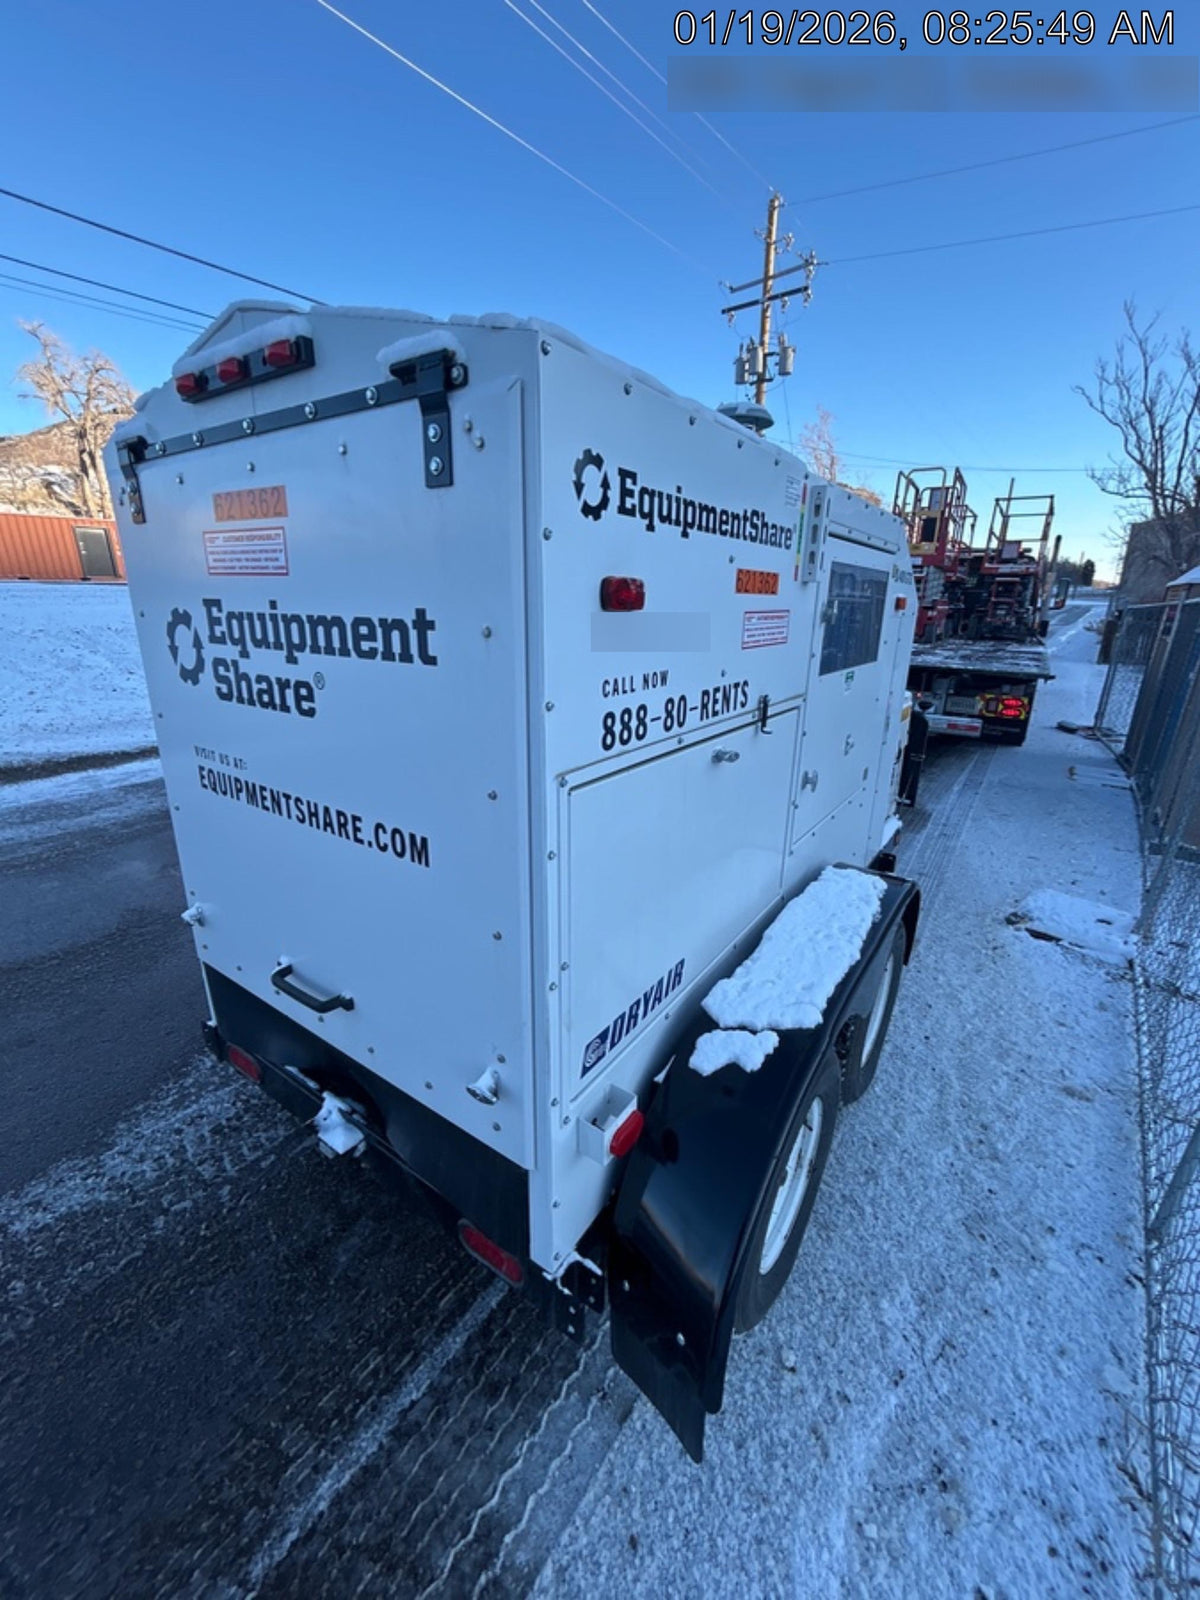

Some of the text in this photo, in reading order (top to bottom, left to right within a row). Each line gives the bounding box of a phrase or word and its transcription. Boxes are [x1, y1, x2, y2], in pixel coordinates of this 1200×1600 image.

[214, 487, 283, 521] 621362
[617, 467, 793, 550] EquipmentShare
[202, 598, 437, 666] Equipment
[602, 669, 669, 698] CALL NOW
[602, 680, 749, 751] 888-80-RENTS
[194, 745, 216, 763] VISIT
[219, 753, 231, 767] US
[198, 764, 430, 868] EQUIPMENTSHARE.COM
[609, 958, 685, 1053] DRYAIR
